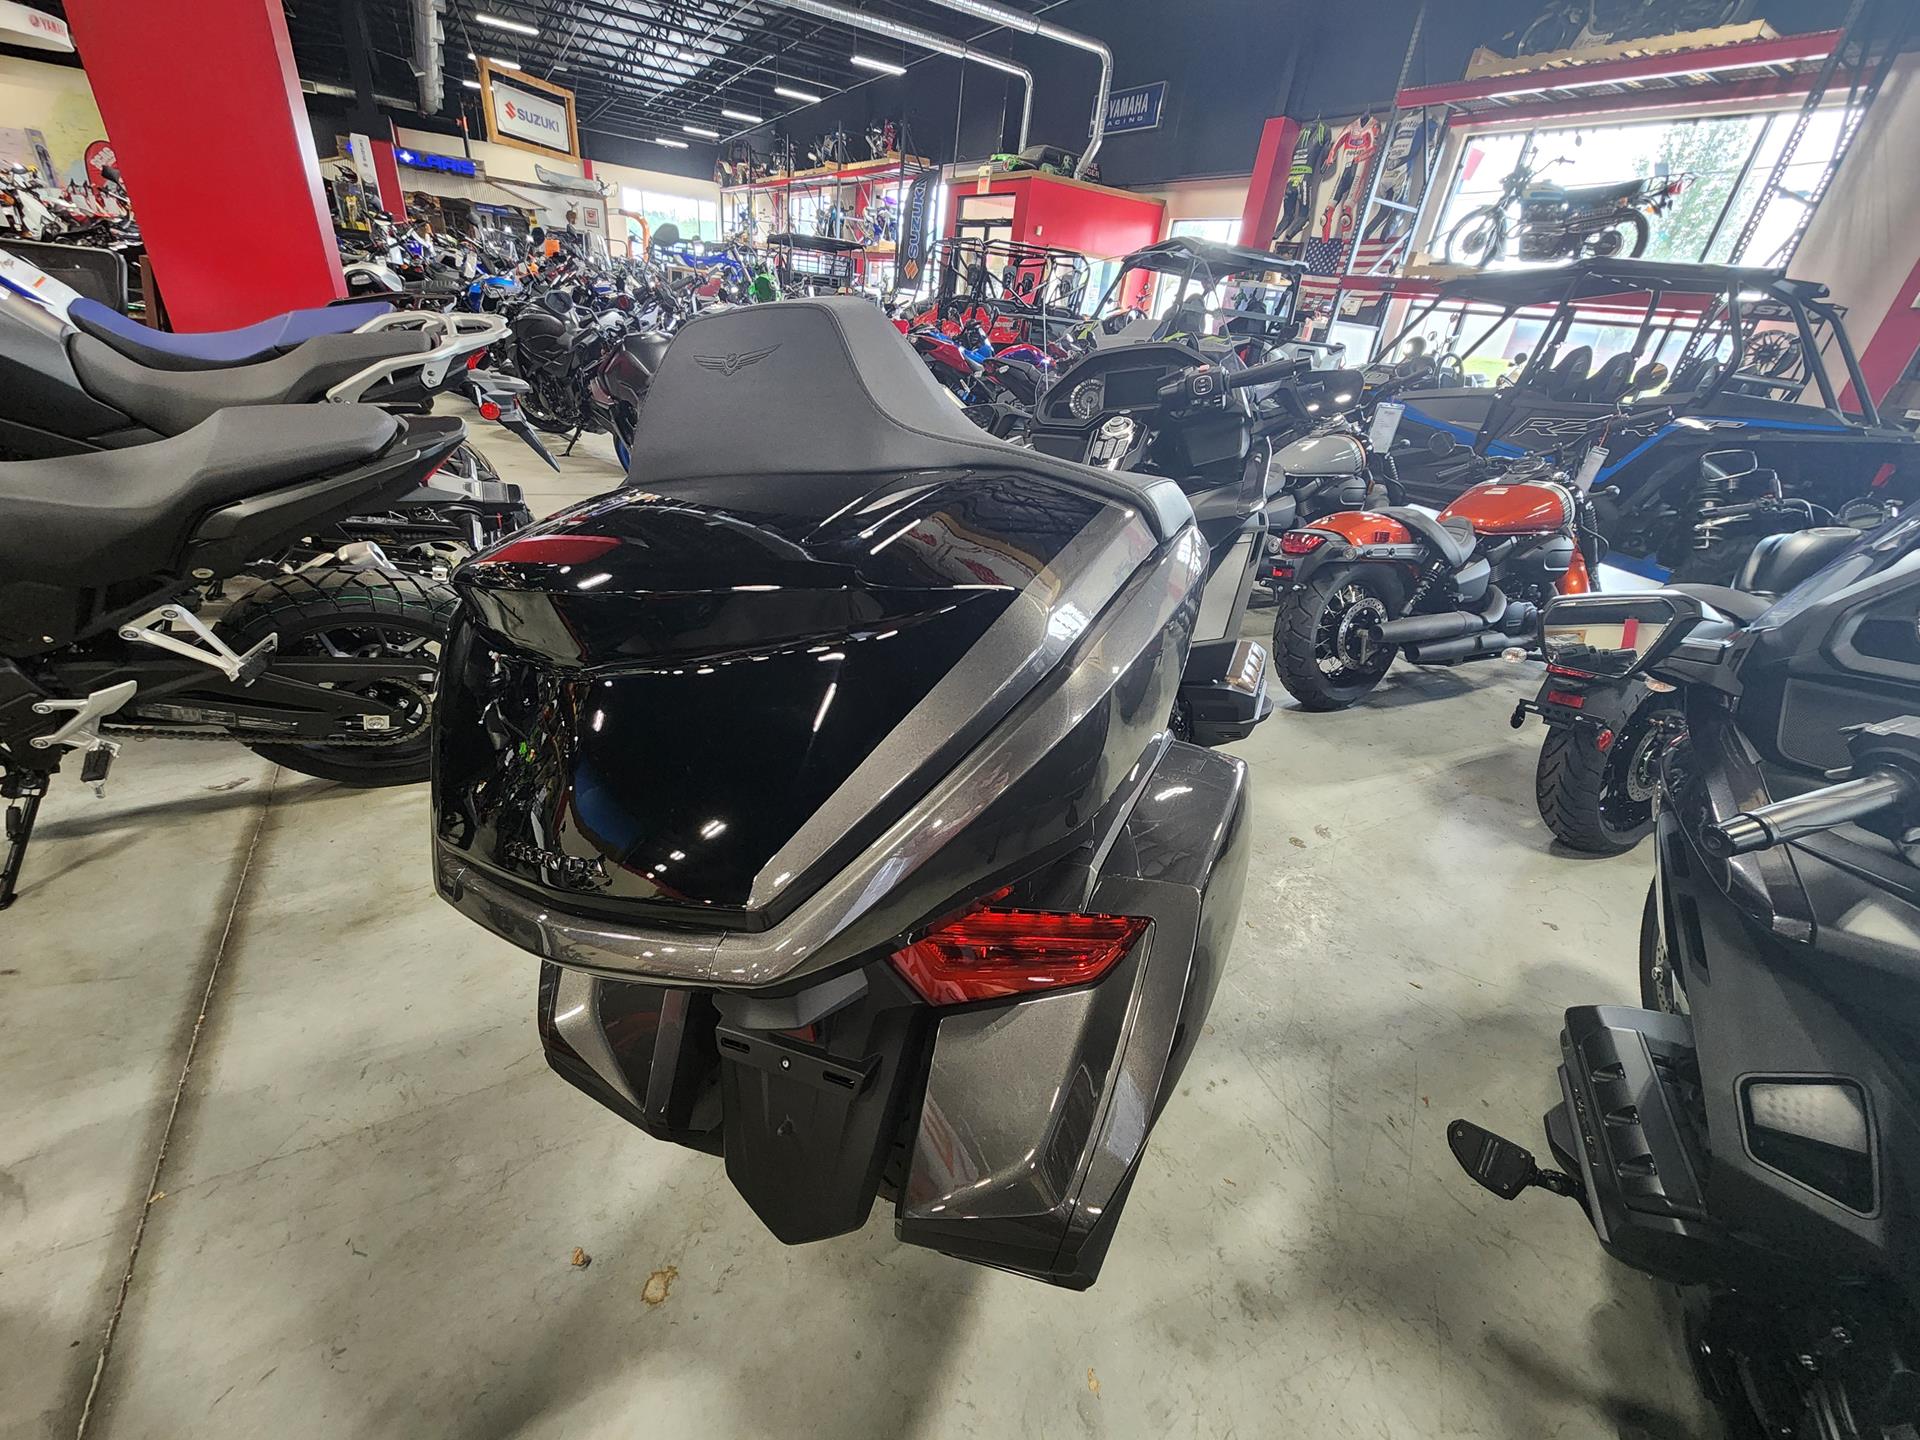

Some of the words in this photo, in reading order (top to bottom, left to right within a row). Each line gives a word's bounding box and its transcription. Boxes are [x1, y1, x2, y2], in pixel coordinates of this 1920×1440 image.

[1109, 93, 1149, 118] YAMAHA
[517, 107, 560, 133] SUZUKI
[1105, 115, 1144, 126] ACING
[907, 180, 927, 259] SUZUKI
